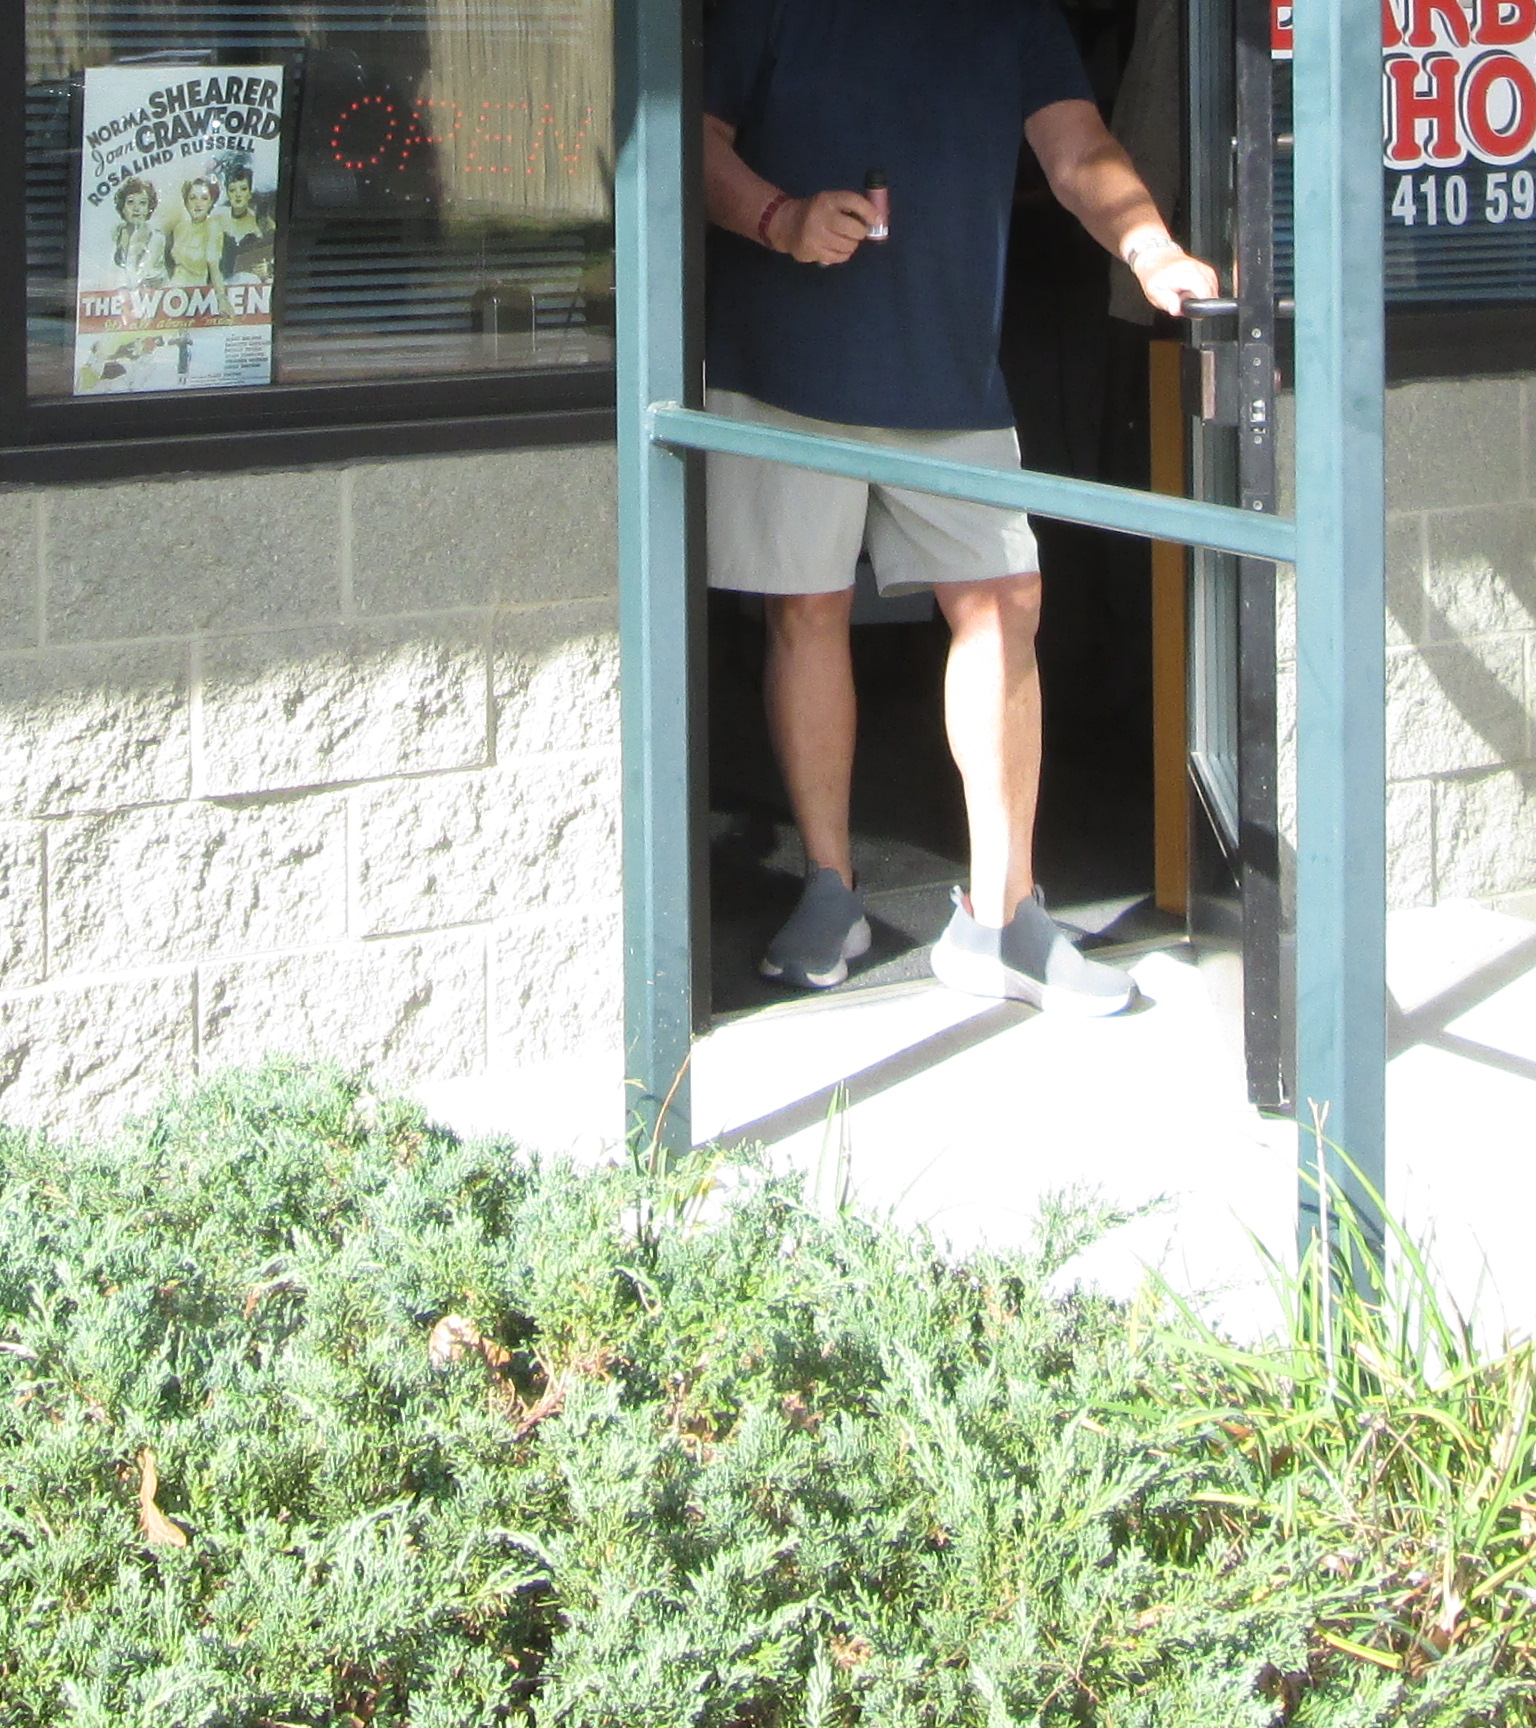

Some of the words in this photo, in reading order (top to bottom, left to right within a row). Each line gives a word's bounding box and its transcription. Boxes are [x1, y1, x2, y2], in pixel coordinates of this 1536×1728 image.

[86, 108, 151, 149] NORMA
[149, 76, 278, 119] SHEARER
[91, 140, 136, 177] Joan
[135, 106, 282, 153] CRAWFORD
[330, 96, 594, 174] OPEN
[87, 149, 174, 207] ROSALIND
[180, 135, 256, 159] RUSSELL
[1392, 174, 1468, 226] 410
[82, 295, 123, 318] THE
[129, 286, 271, 319] WOMEN
